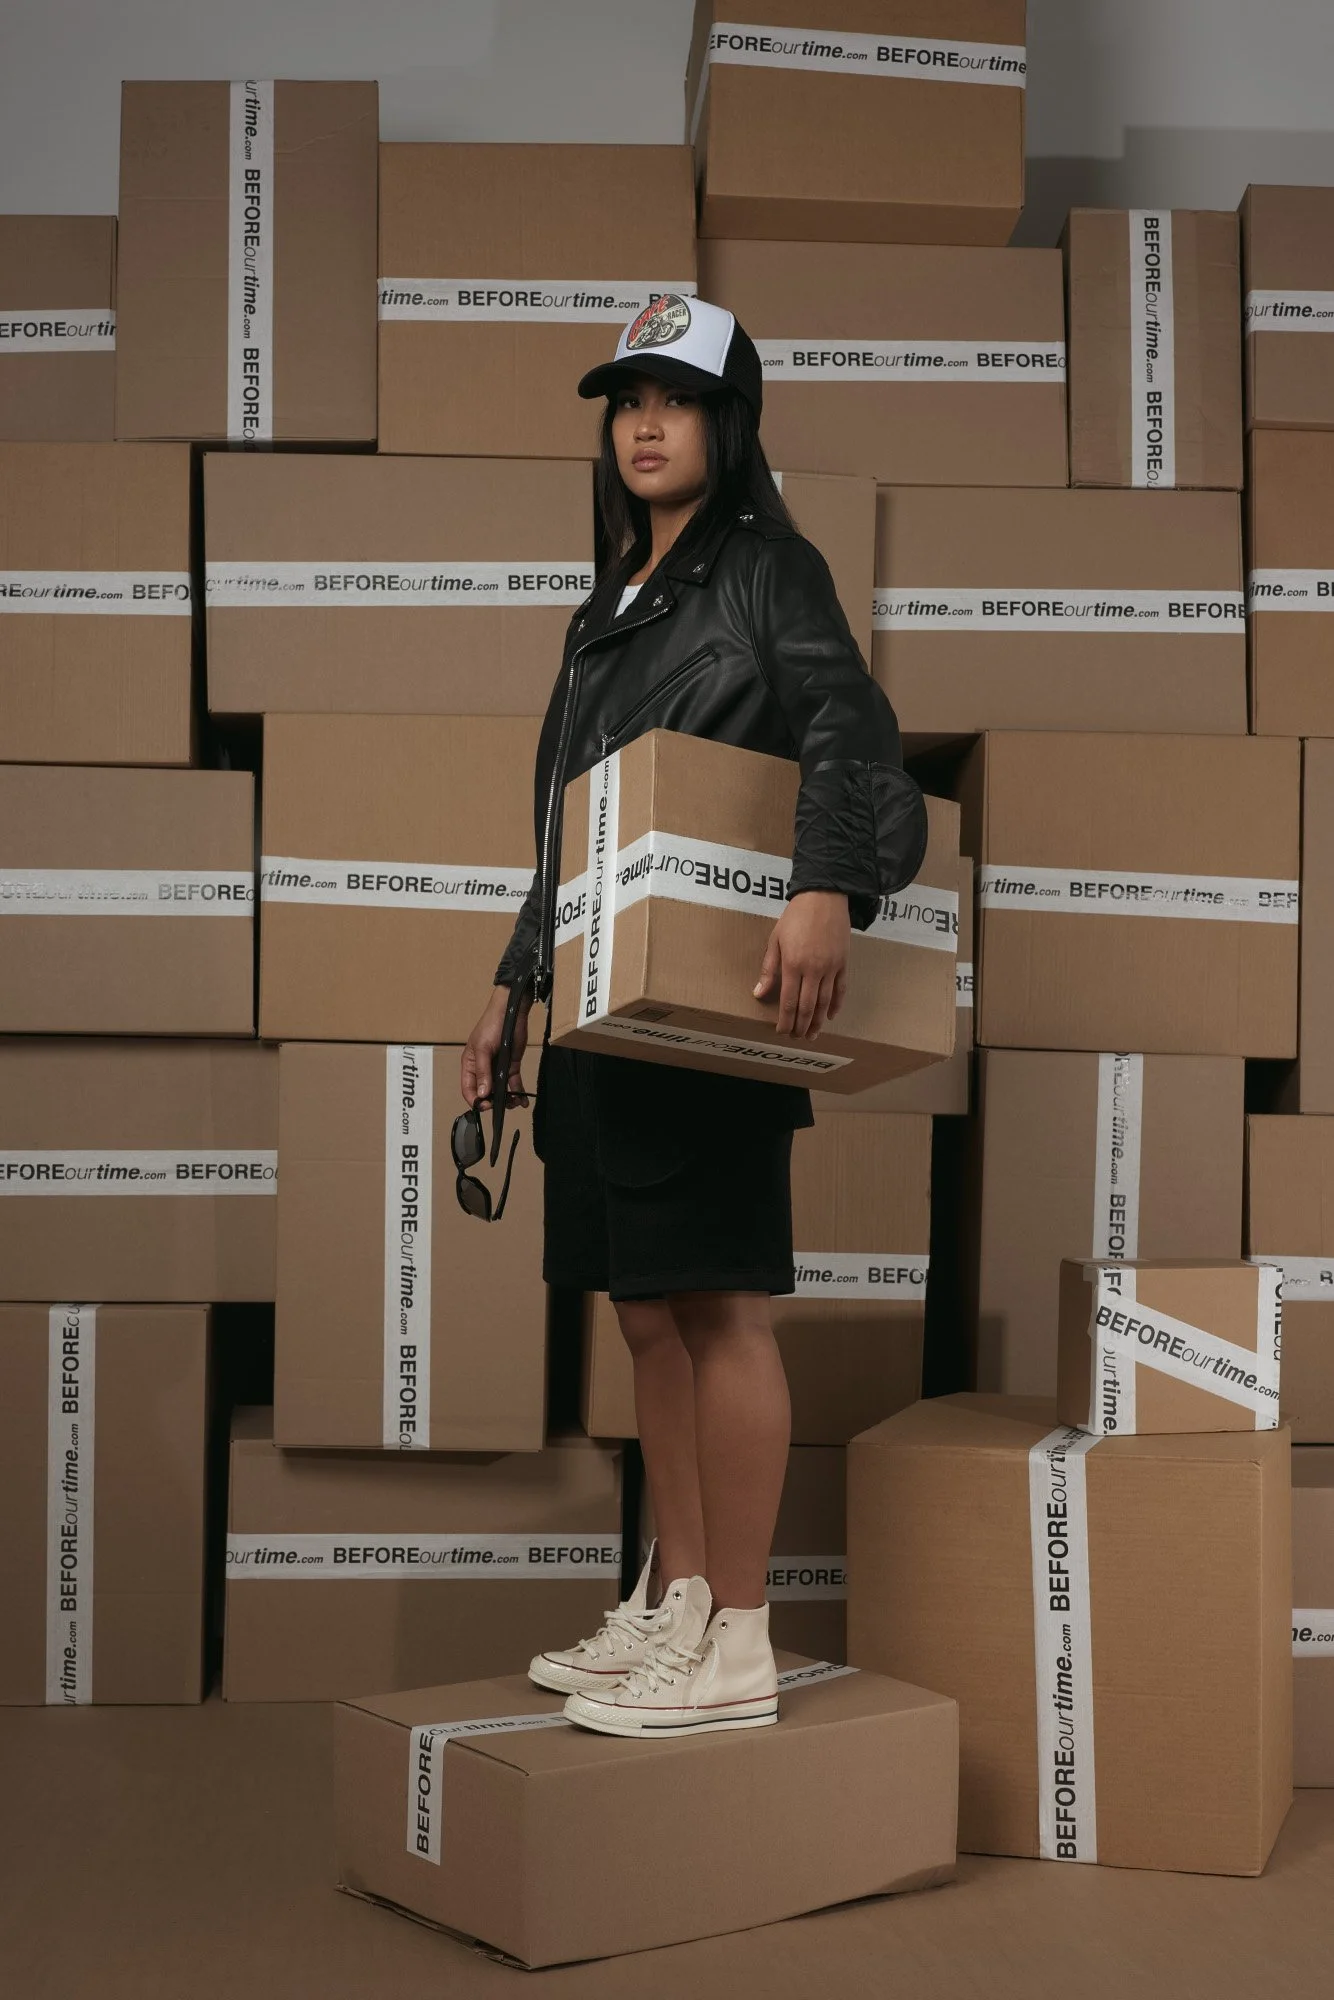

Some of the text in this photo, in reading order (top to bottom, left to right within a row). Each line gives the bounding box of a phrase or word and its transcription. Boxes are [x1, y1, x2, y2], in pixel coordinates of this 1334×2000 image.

[244, 80, 260, 160] urtime.com
[243, 169, 260, 339] BEFOREourtime.com
[381, 290, 448, 306] time.com
[458, 290, 640, 309] BEFOREourtime.com
[1143, 217, 1161, 383] BEFOREourtime.com
[793, 351, 968, 368] BEFOREourtime.com
[314, 575, 499, 592] BEFOREourtime.com
[982, 601, 1160, 619] BEFOREourtime.com
[586, 760, 610, 1018] BEFOREourtime.com
[601, 1021, 836, 1070] BEFOREourtime.com
[399, 1144, 419, 1336] BEFOREourtime.com
[1096, 1306, 1280, 1400] BEFOREourtime.com
[60, 1423, 79, 1612] BEFOREourtime.com
[333, 1547, 519, 1564] BEFOREourtime.com
[1053, 1624, 1077, 1860] BEFOREourtime.com
